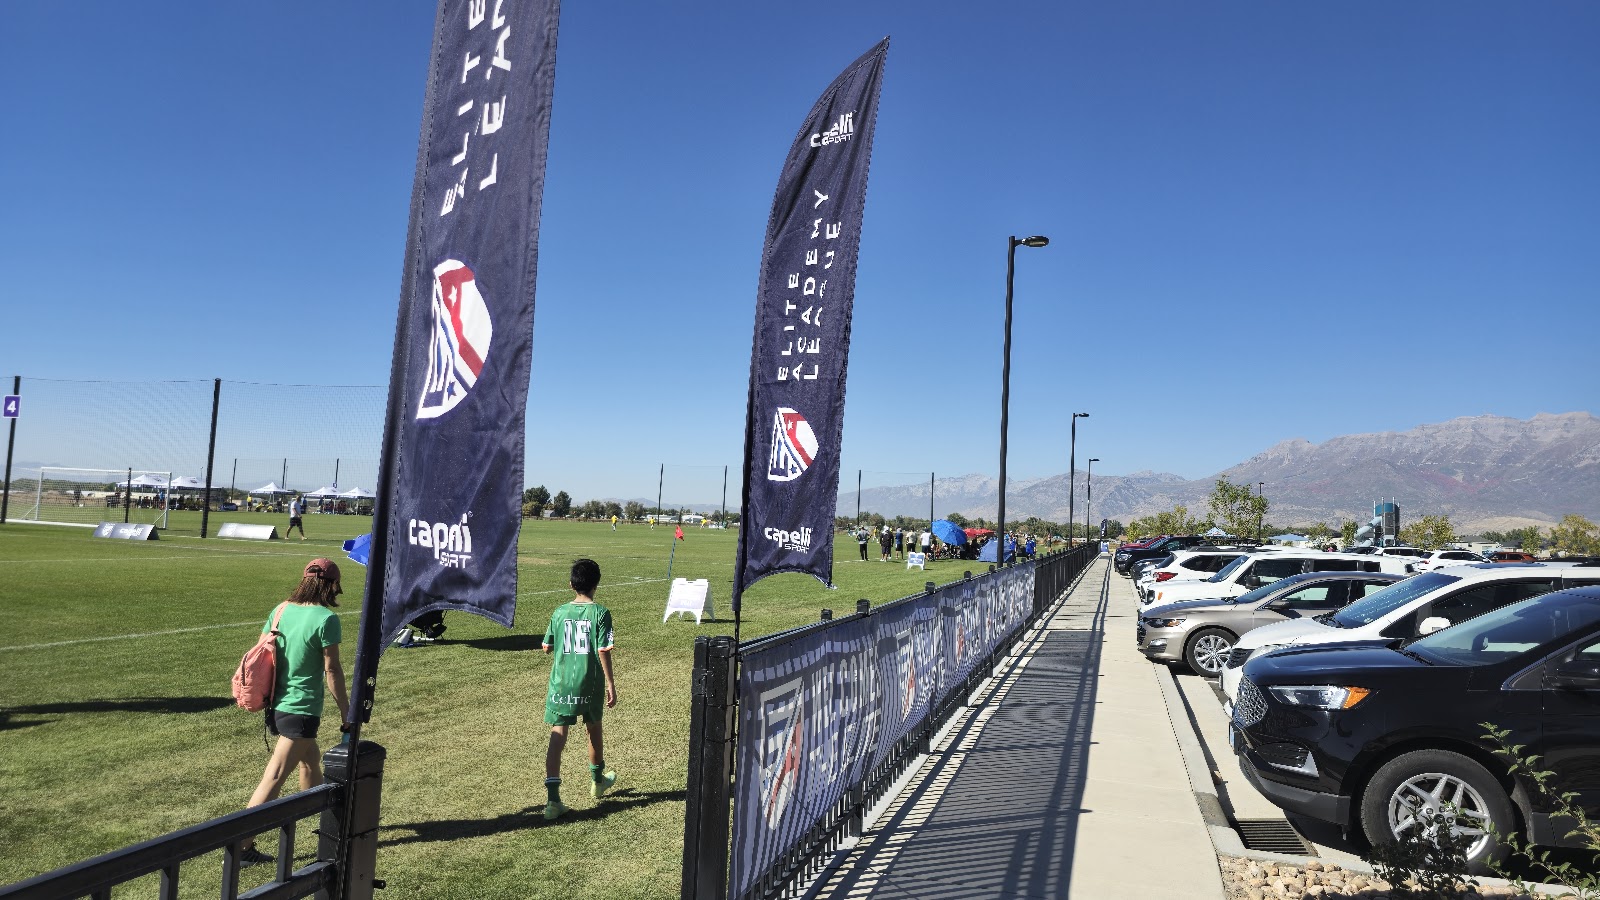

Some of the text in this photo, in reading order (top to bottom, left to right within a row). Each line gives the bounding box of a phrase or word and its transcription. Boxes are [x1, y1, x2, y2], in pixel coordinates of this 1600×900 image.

[811, 111, 854, 148] caelli
[828, 133, 854, 144] PORT
[792, 189, 829, 381] ACADEMY
[777, 272, 800, 381] ELITE
[7, 400, 17, 413] 4
[764, 526, 811, 548] capelli
[563, 618, 591, 654] 16
